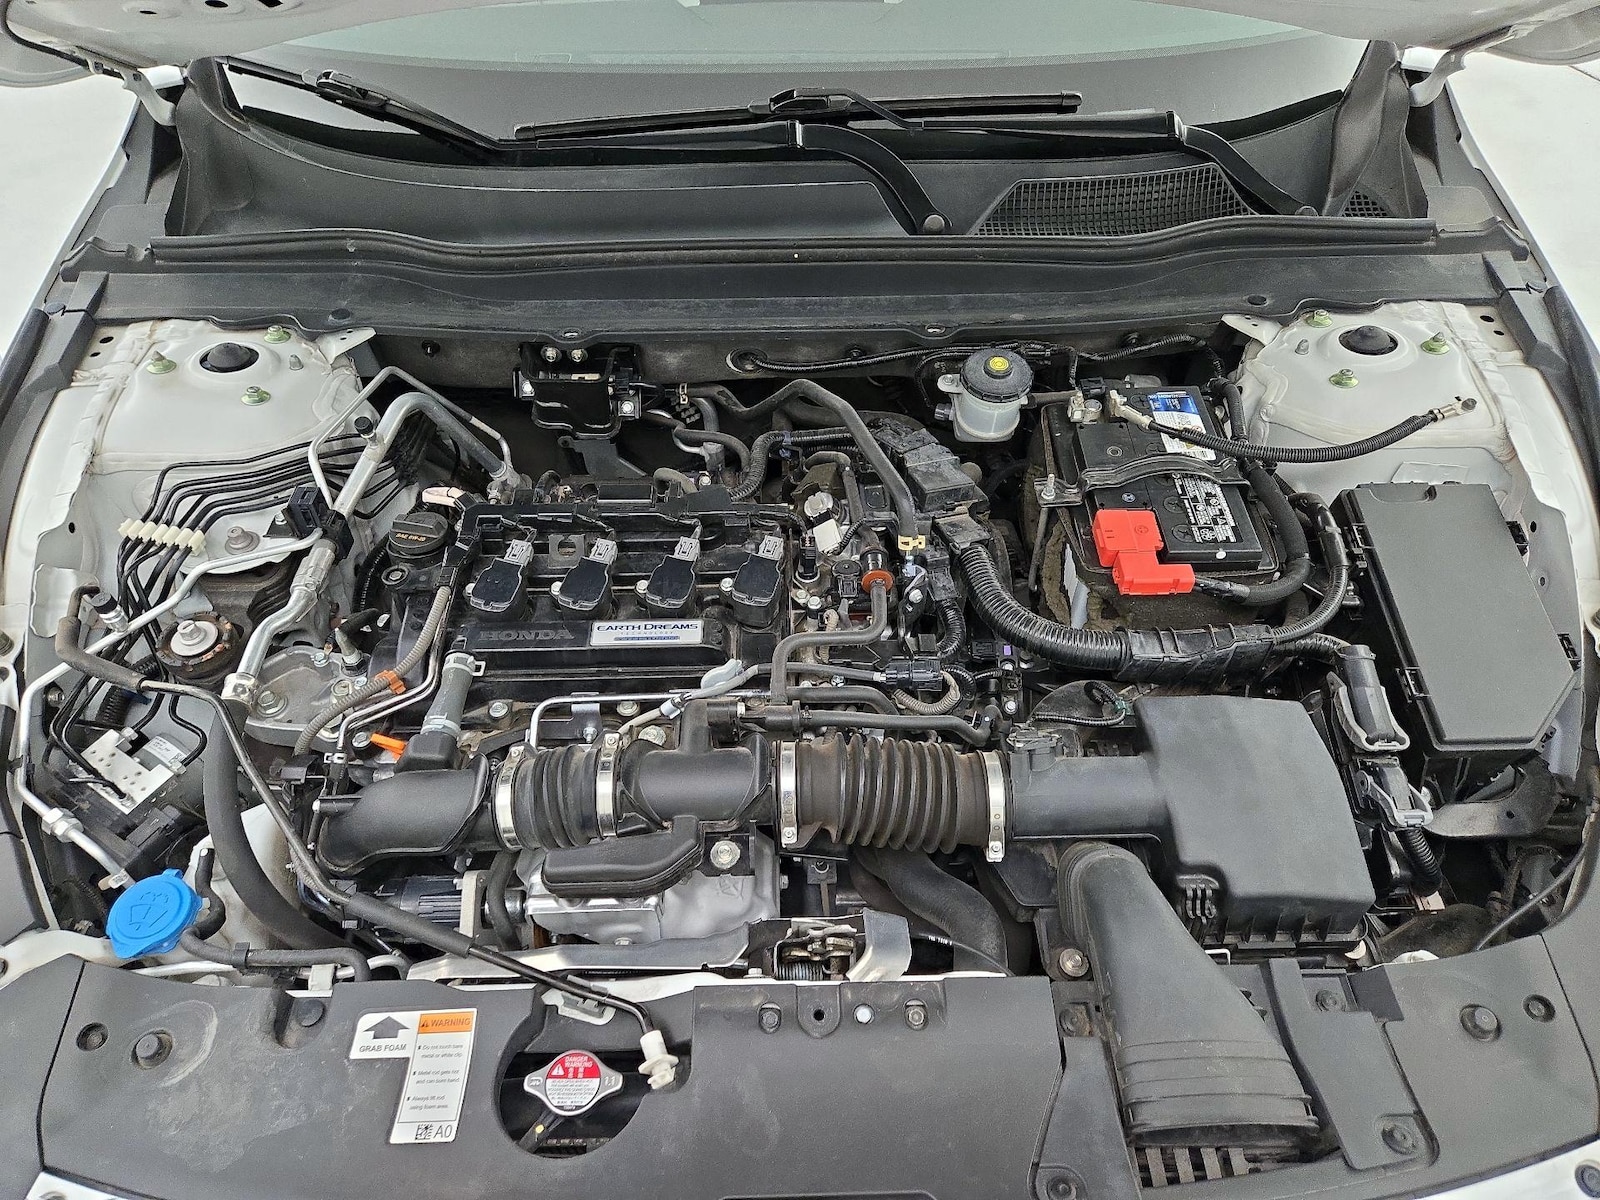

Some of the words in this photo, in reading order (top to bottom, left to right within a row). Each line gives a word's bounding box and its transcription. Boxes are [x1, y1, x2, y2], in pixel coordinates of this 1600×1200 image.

[644, 623, 698, 631] DREAMS
[479, 629, 575, 641] HONDA
[431, 1018, 471, 1027] WARNING
[359, 1045, 382, 1053] GRAB
[384, 1044, 407, 1052] FOAM
[604, 1076, 616, 1086] 1.1
[433, 1124, 453, 1139] A0
